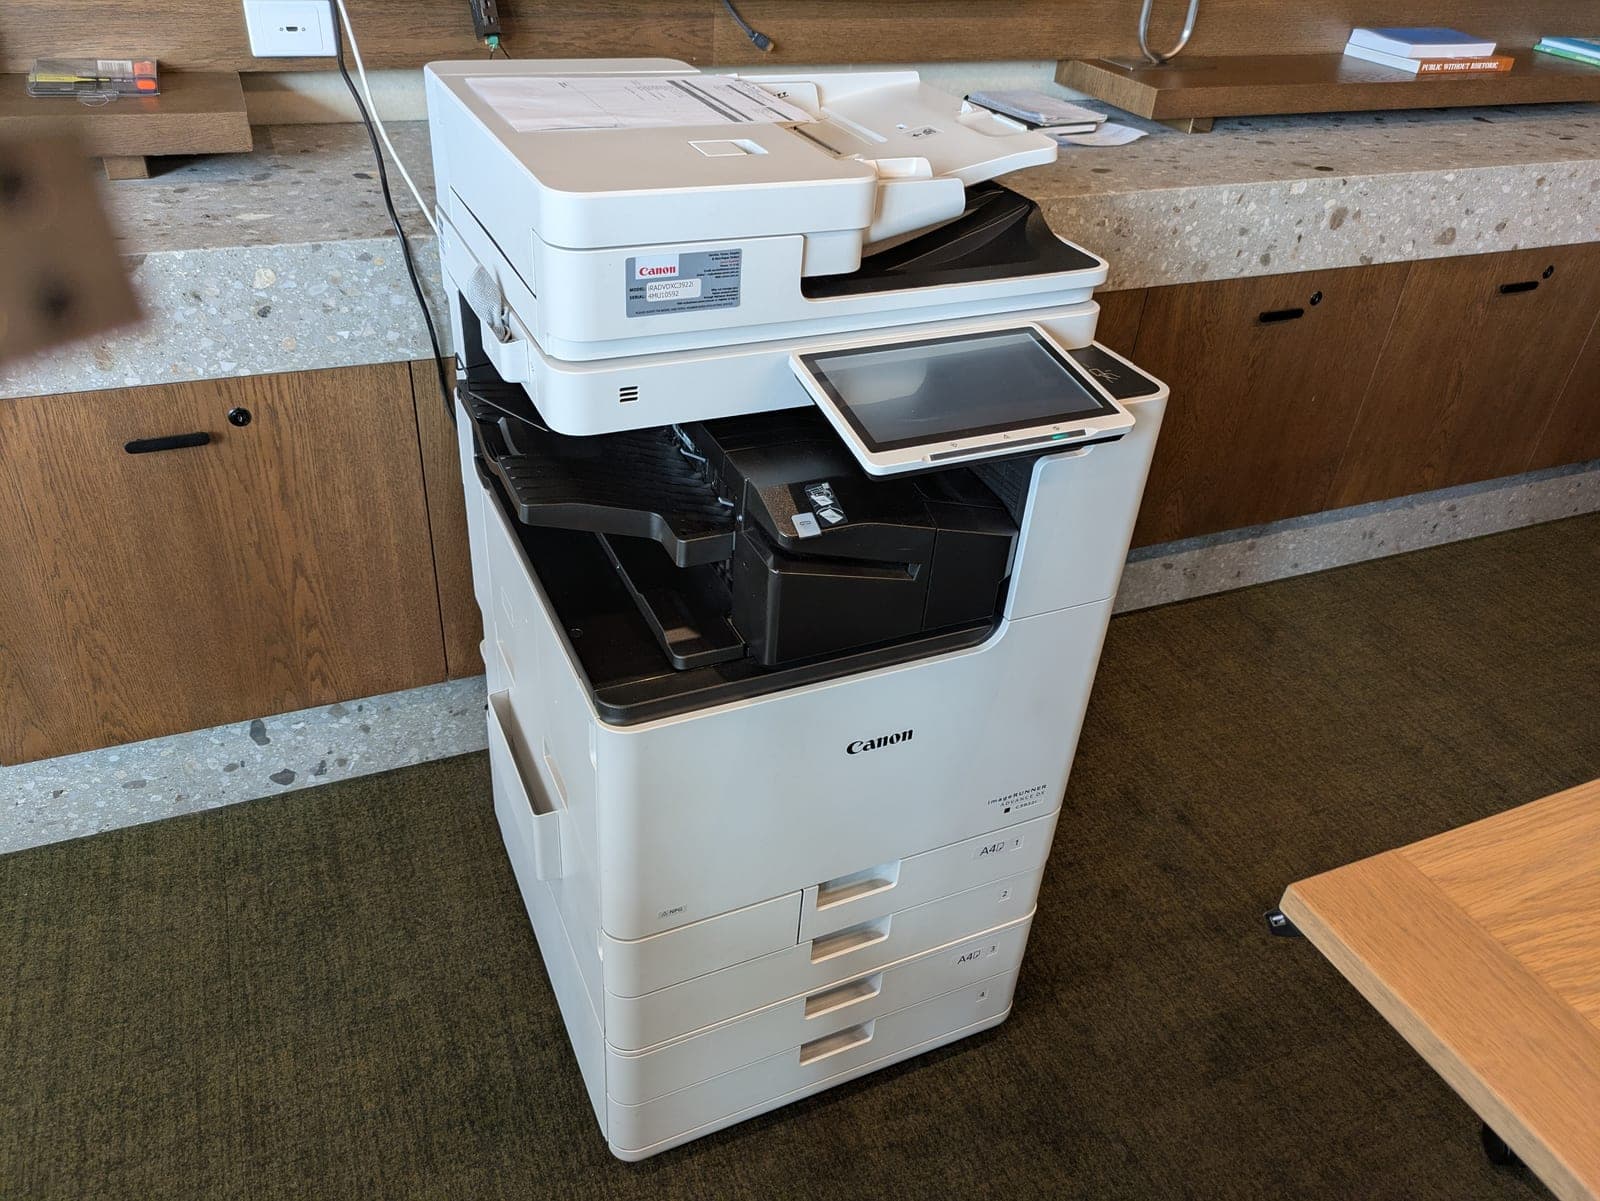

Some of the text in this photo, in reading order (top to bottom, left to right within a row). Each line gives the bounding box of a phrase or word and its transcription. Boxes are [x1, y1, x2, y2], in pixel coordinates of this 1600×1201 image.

[1421, 63, 1442, 71] PUBLIC
[1443, 62, 1470, 71] WITHOUT
[639, 265, 676, 276] Canon
[846, 729, 914, 755] Canon
[979, 844, 996, 857] A4
[957, 952, 973, 965] A4
